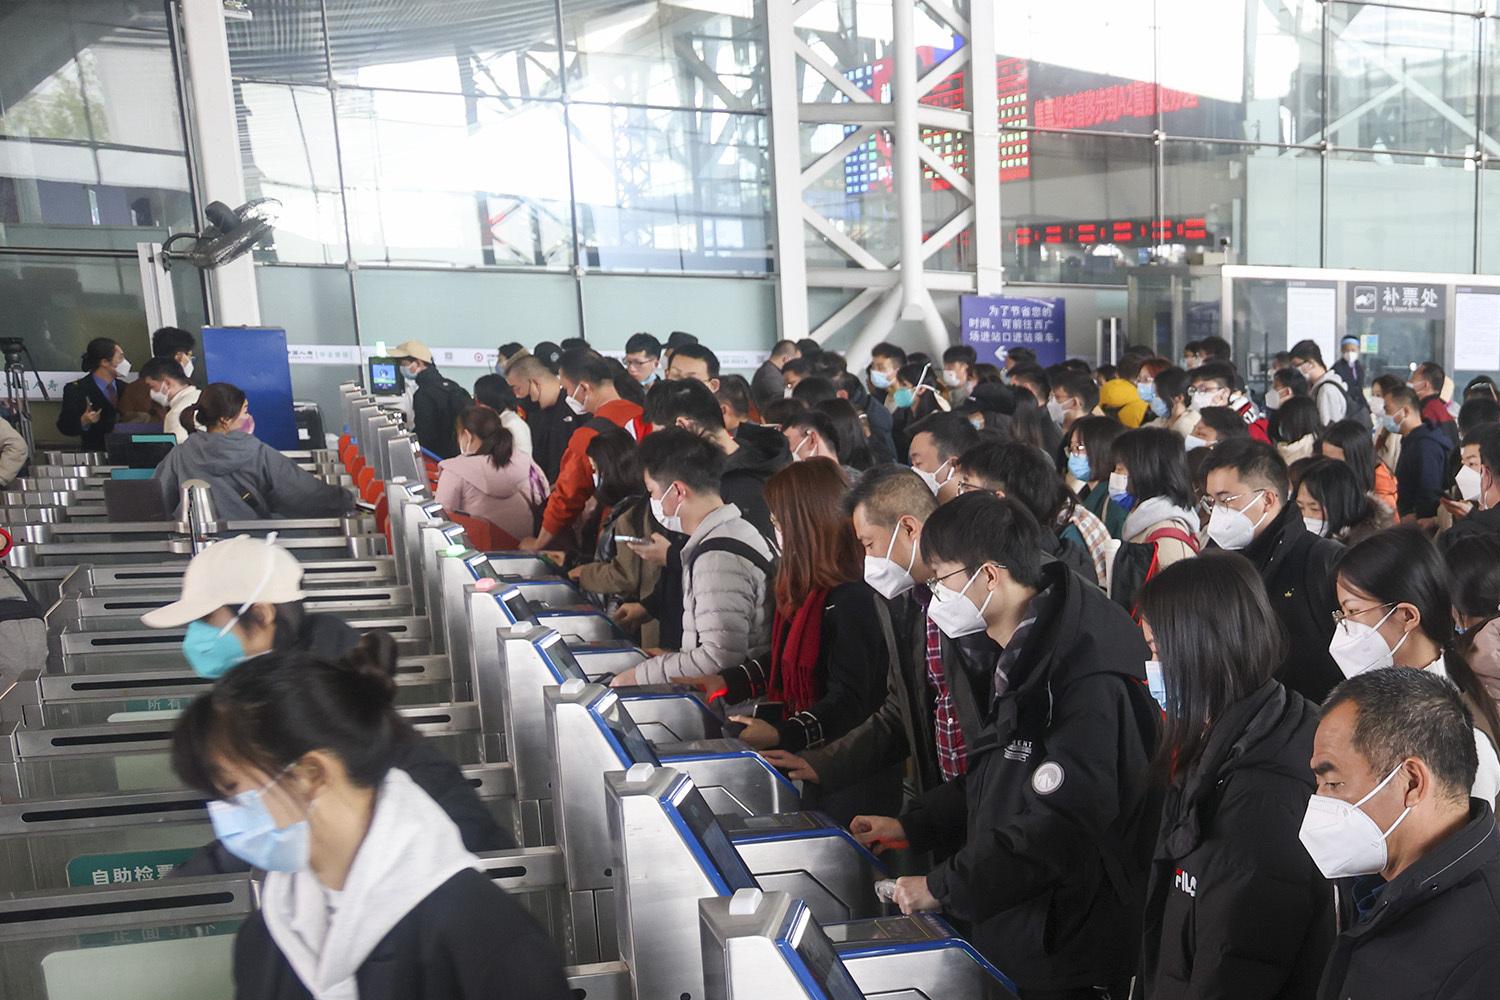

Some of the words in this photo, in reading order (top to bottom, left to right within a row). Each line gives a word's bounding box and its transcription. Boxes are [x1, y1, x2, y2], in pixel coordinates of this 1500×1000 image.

[1382, 287, 1438, 308] 补票处
[989, 305, 1052, 317] 为了节省您的
[969, 318, 1053, 329] 时间，可前往西广
